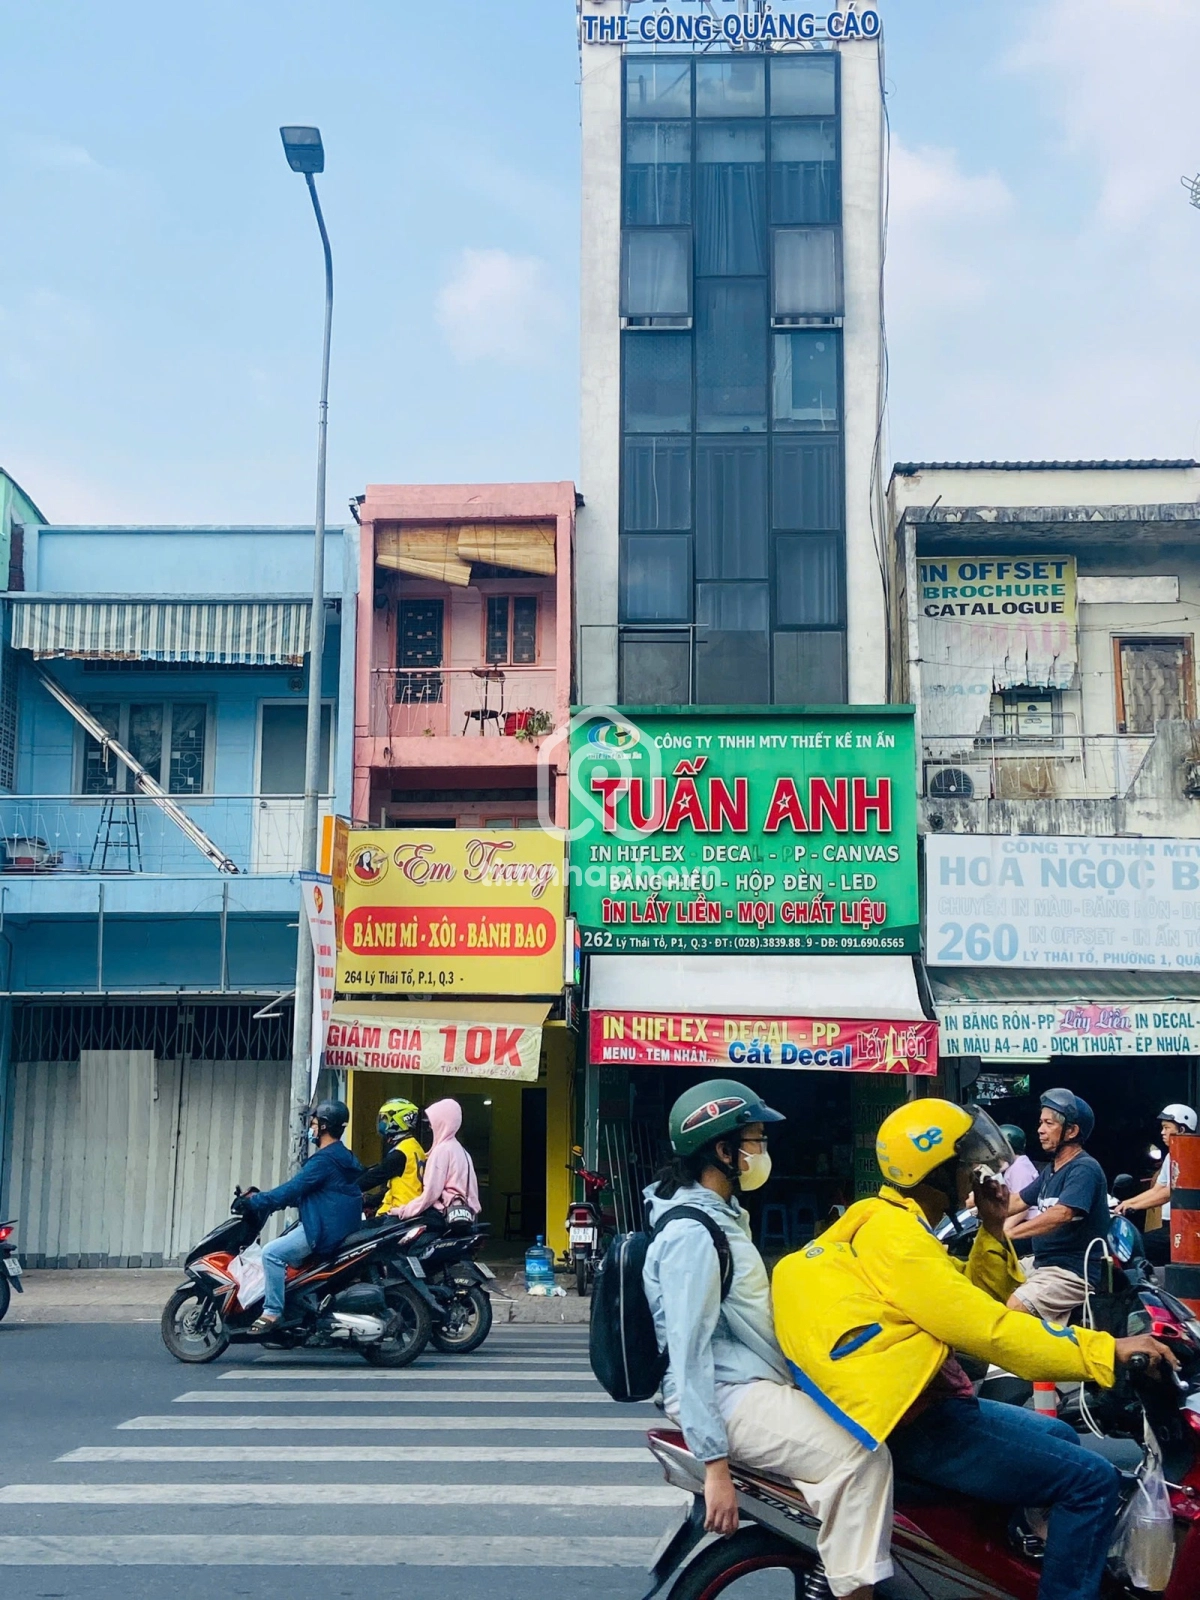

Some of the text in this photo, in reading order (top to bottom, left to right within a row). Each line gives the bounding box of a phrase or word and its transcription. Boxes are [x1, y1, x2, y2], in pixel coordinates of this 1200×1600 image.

[583, 3, 880, 45] THI CÔNG QUẢNG CÁO
[920, 561, 1068, 583] IN OFFSET
[923, 584, 1066, 599] BROCHURE
[924, 601, 1065, 618] CATALOGUE
[654, 730, 895, 749] CÔNG TY TNHH MTV THIẾT KẾ IN ẤN
[591, 756, 892, 832] TUẤN ANH
[590, 845, 611, 861] IN
[617, 845, 684, 861] HIFLEX
[823, 845, 899, 862] CANVAS
[1066, 842, 1092, 855] TY
[1098, 843, 1155, 857] TNHH
[394, 843, 455, 884] Em
[464, 839, 555, 899] Trang
[939, 856, 1024, 887] HOA
[1040, 858, 1155, 895] NGỌC
[610, 868, 662, 890] BẢNG
[736, 869, 775, 896] HỘP
[783, 868, 822, 891] ĐÈN
[841, 874, 877, 890] LED
[631, 892, 671, 923] LẤY
[676, 892, 721, 923] LIỀN
[738, 901, 775, 930] MỌI
[780, 892, 835, 924] CHẤT
[840, 897, 887, 930] LIỆU
[1012, 898, 1029, 916] IN
[1034, 895, 1072, 918] MÀU
[353, 915, 396, 947] BÁNH
[400, 915, 418, 947] MÌ
[429, 915, 456, 947] XÔI
[467, 915, 511, 948] BÁNH
[514, 923, 547, 948] BAO
[584, 932, 613, 947] 262
[616, 937, 627, 949] Lý
[629, 937, 650, 948] Thái
[841, 938, 905, 948] 091.690.6565
[937, 922, 1019, 961] 260
[1029, 925, 1046, 944] IN
[1051, 925, 1115, 945] OFFSET
[1133, 928, 1151, 946] IN
[344, 971, 362, 984] 264
[365, 971, 376, 986] Lý
[379, 971, 398, 984] Thái
[439, 971, 454, 987] Q.3
[603, 1016, 624, 1040] IN
[632, 1016, 709, 1042] HIFLEX
[723, 1019, 793, 1044] DECAL
[812, 1022, 841, 1047] PP
[945, 1015, 958, 1031] IN
[963, 1011, 999, 1030] BĂNG
[1002, 1010, 1031, 1030] RÔN
[1060, 1010, 1091, 1032] Lấy
[1135, 1013, 1148, 1029] IN
[1153, 1012, 1195, 1028] DECAL
[326, 1020, 422, 1051] GIẢM GIÁ
[439, 1025, 526, 1066] 10K
[857, 1026, 927, 1062] Lấy Liền
[947, 1038, 959, 1054] IN
[963, 1033, 990, 1053] MÀU
[994, 1038, 1010, 1053] A4
[1136, 1033, 1152, 1052] ÉP
[326, 1050, 422, 1070] KHAI TRƯƠNG
[603, 1046, 636, 1060] MENU
[646, 1048, 670, 1061] TEM
[728, 1038, 852, 1067] Cắt Decal
